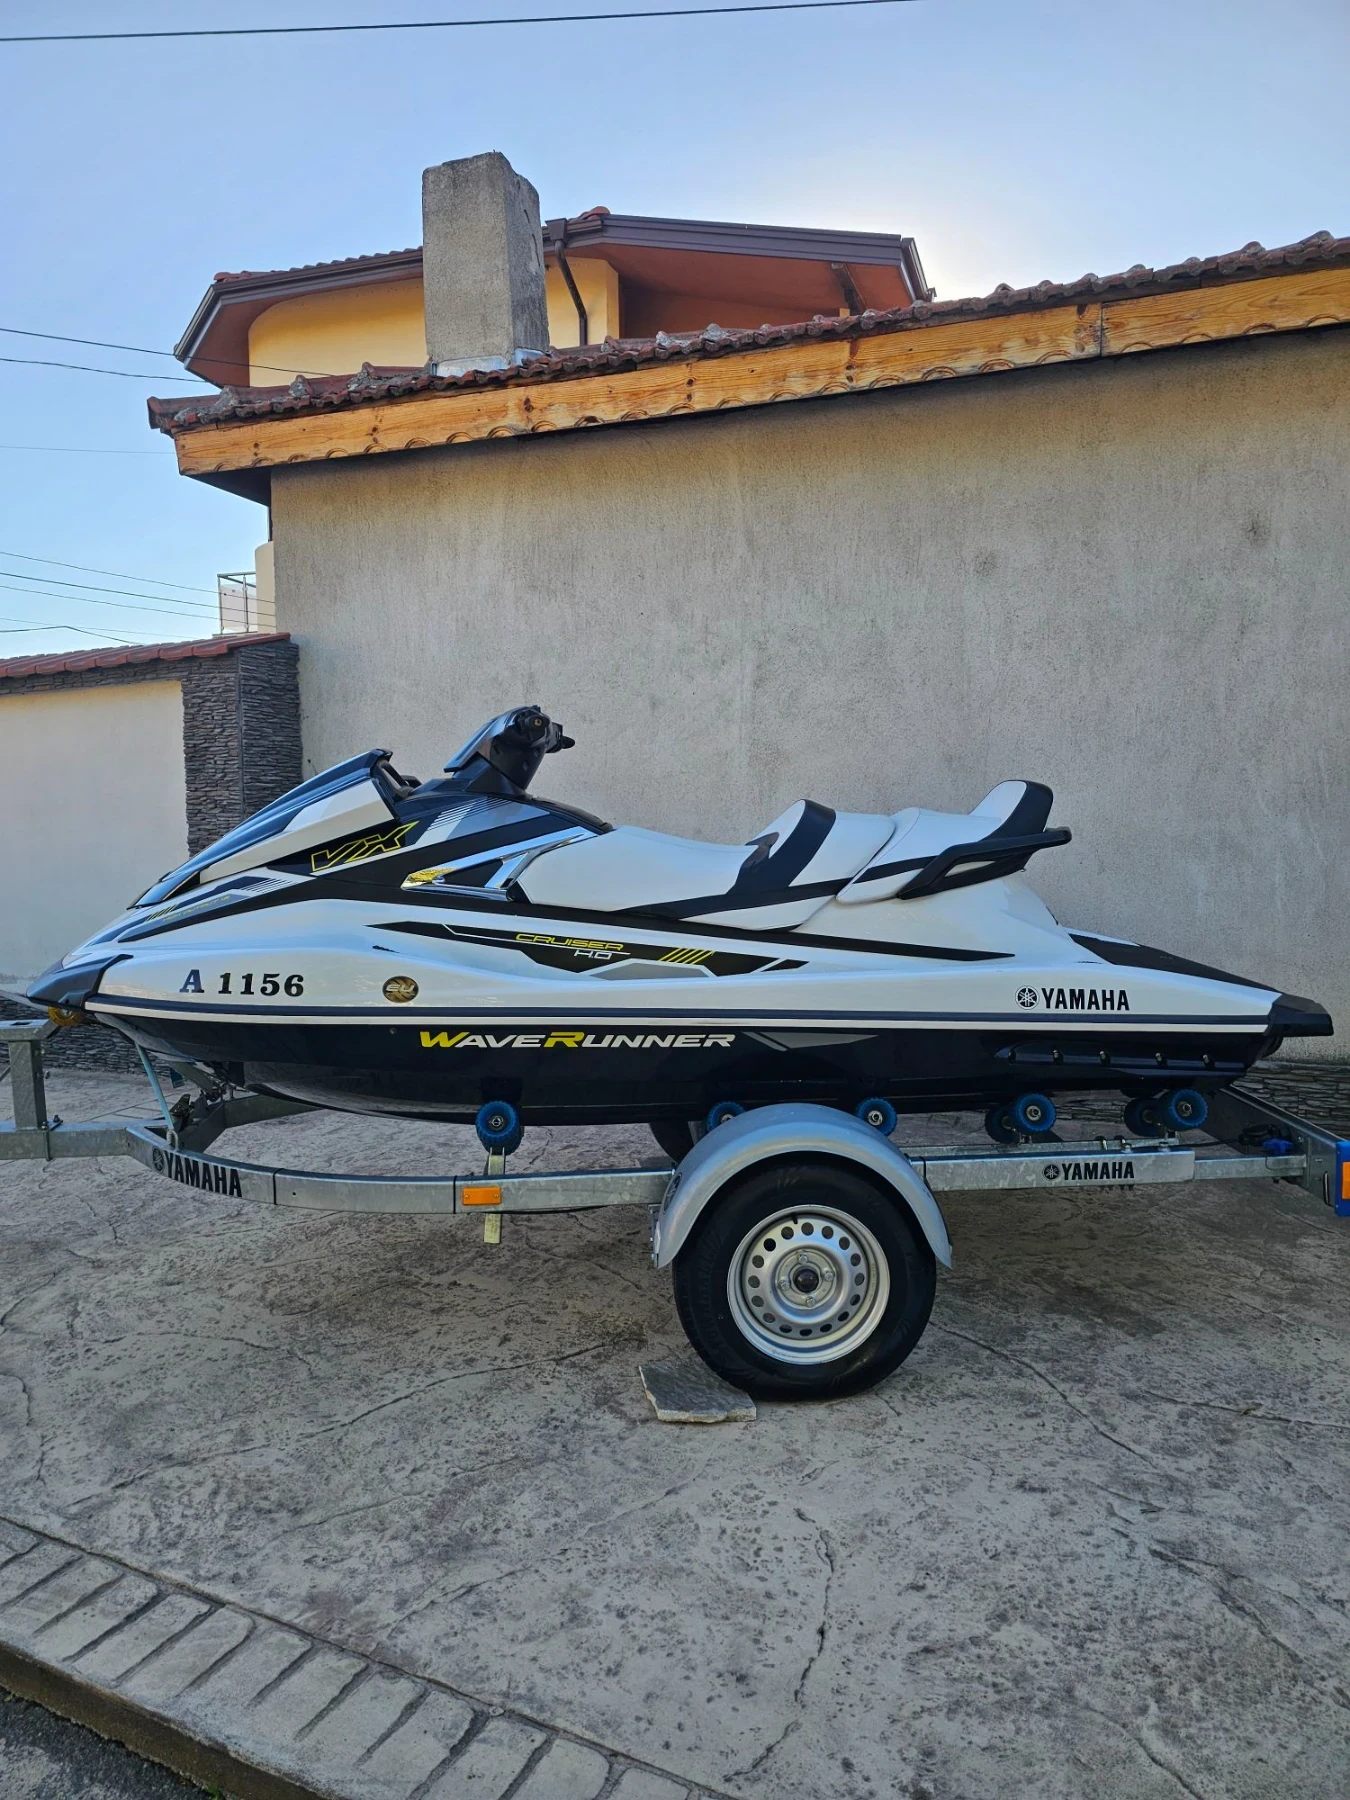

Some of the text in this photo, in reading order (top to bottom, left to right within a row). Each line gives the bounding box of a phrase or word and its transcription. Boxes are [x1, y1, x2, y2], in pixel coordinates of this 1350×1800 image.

[311, 820, 420, 872] VX
[515, 933, 624, 951] CRUISER
[179, 969, 304, 997] A 1156
[1041, 987, 1130, 1011] YAMAHA
[163, 1149, 243, 1198] YAMAHA
[1061, 1161, 1135, 1181] YAMAHA
